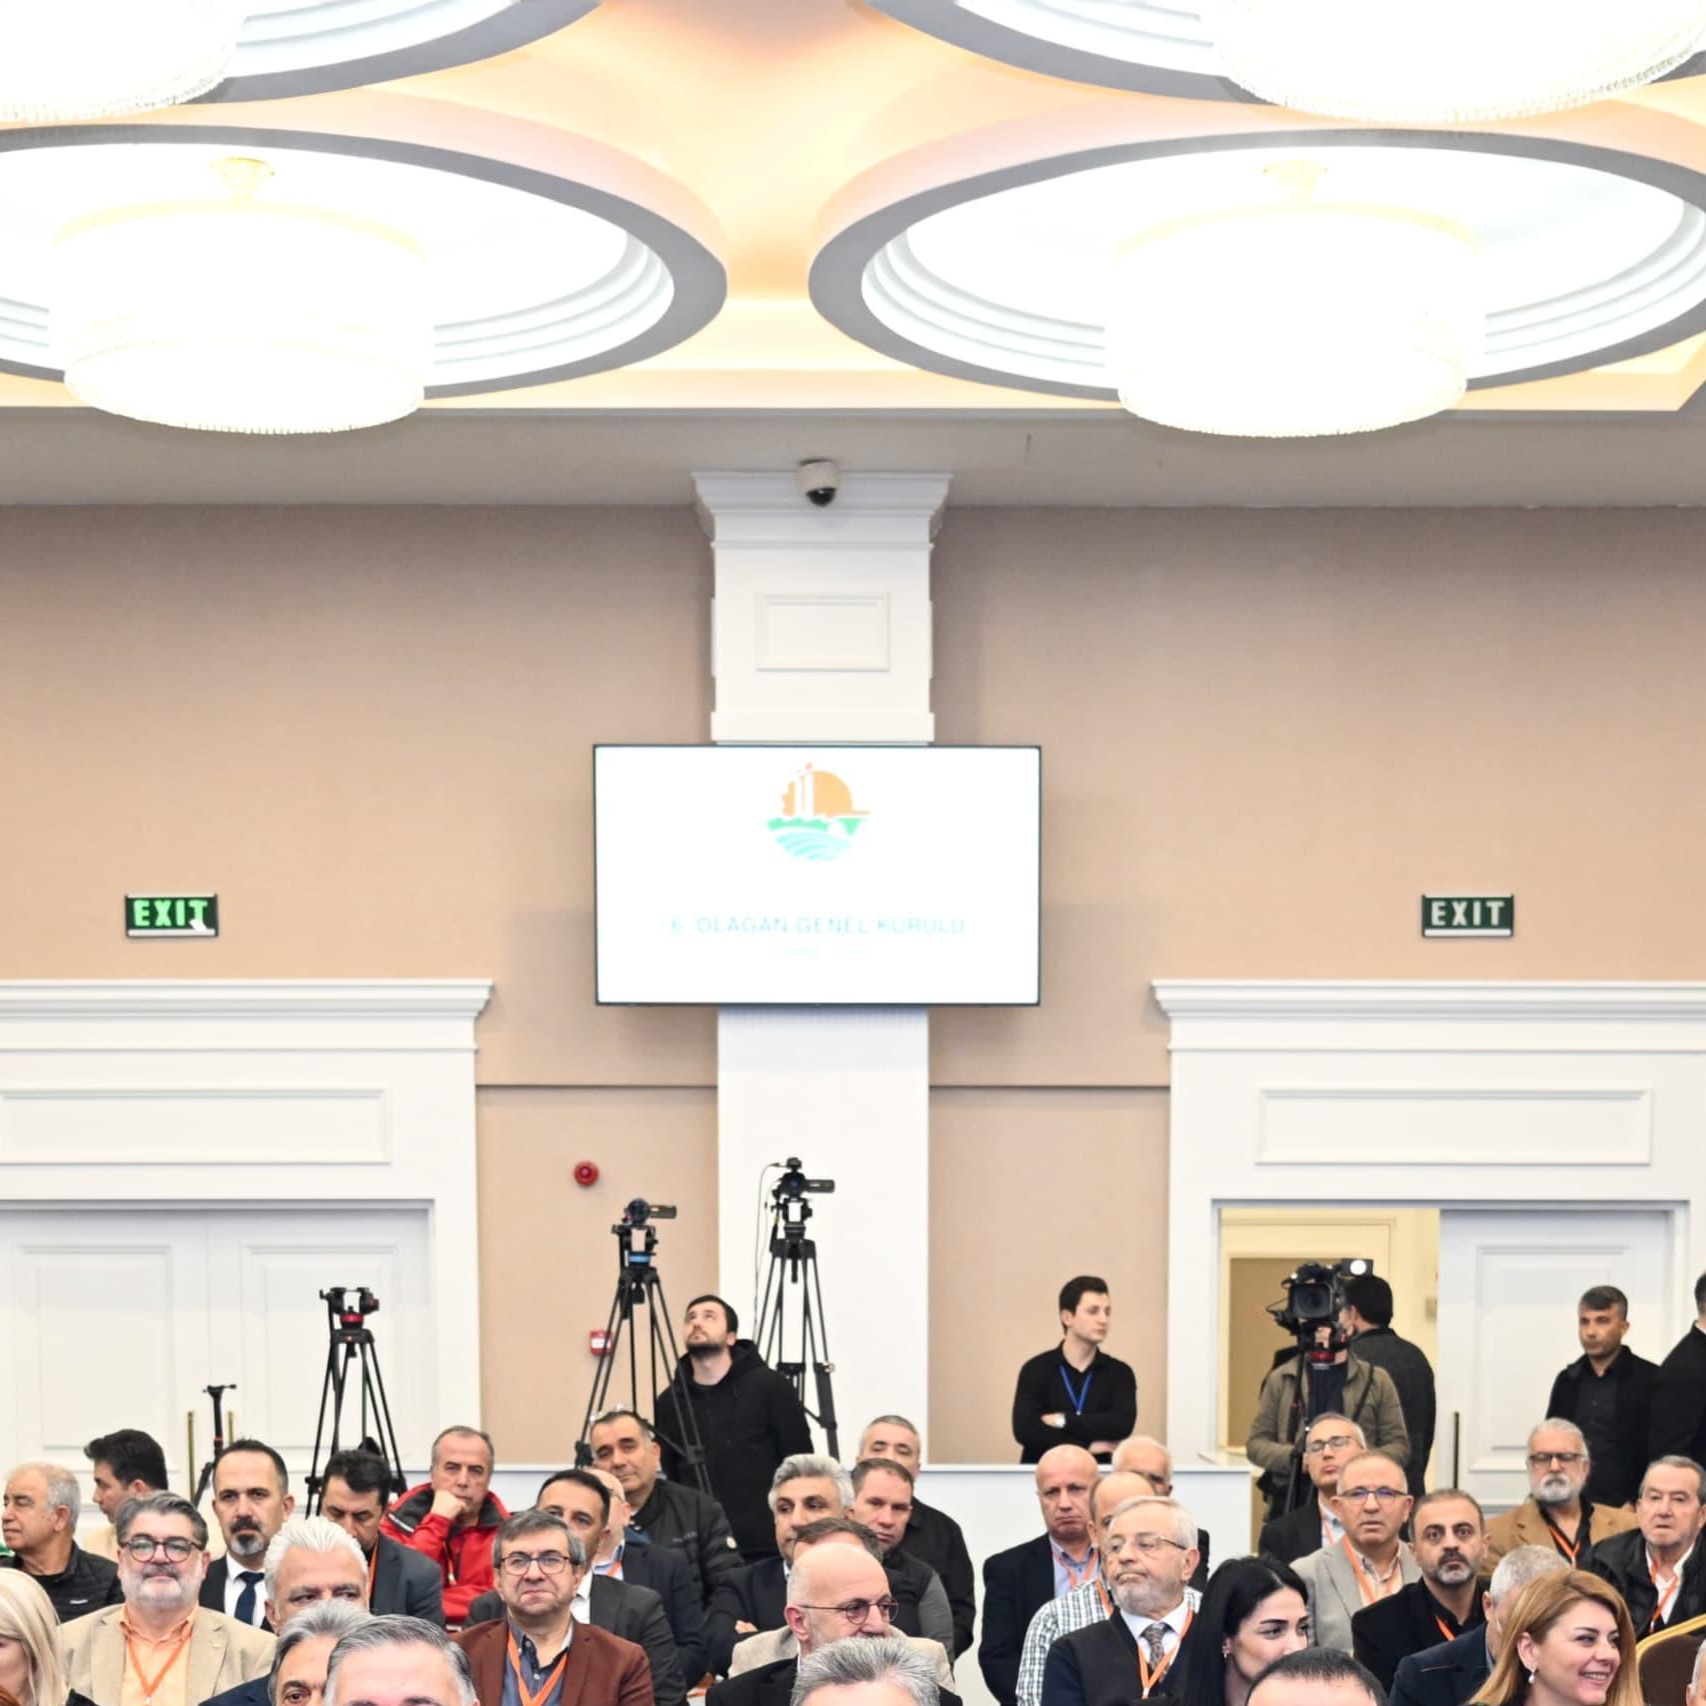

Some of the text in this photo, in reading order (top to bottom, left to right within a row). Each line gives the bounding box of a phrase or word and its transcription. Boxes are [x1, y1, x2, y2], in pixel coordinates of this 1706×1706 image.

[132, 899, 208, 927] EXIT
[796, 916, 869, 934] GENEL
[877, 917, 965, 934] KURULU
[1430, 900, 1504, 926] EXIT
